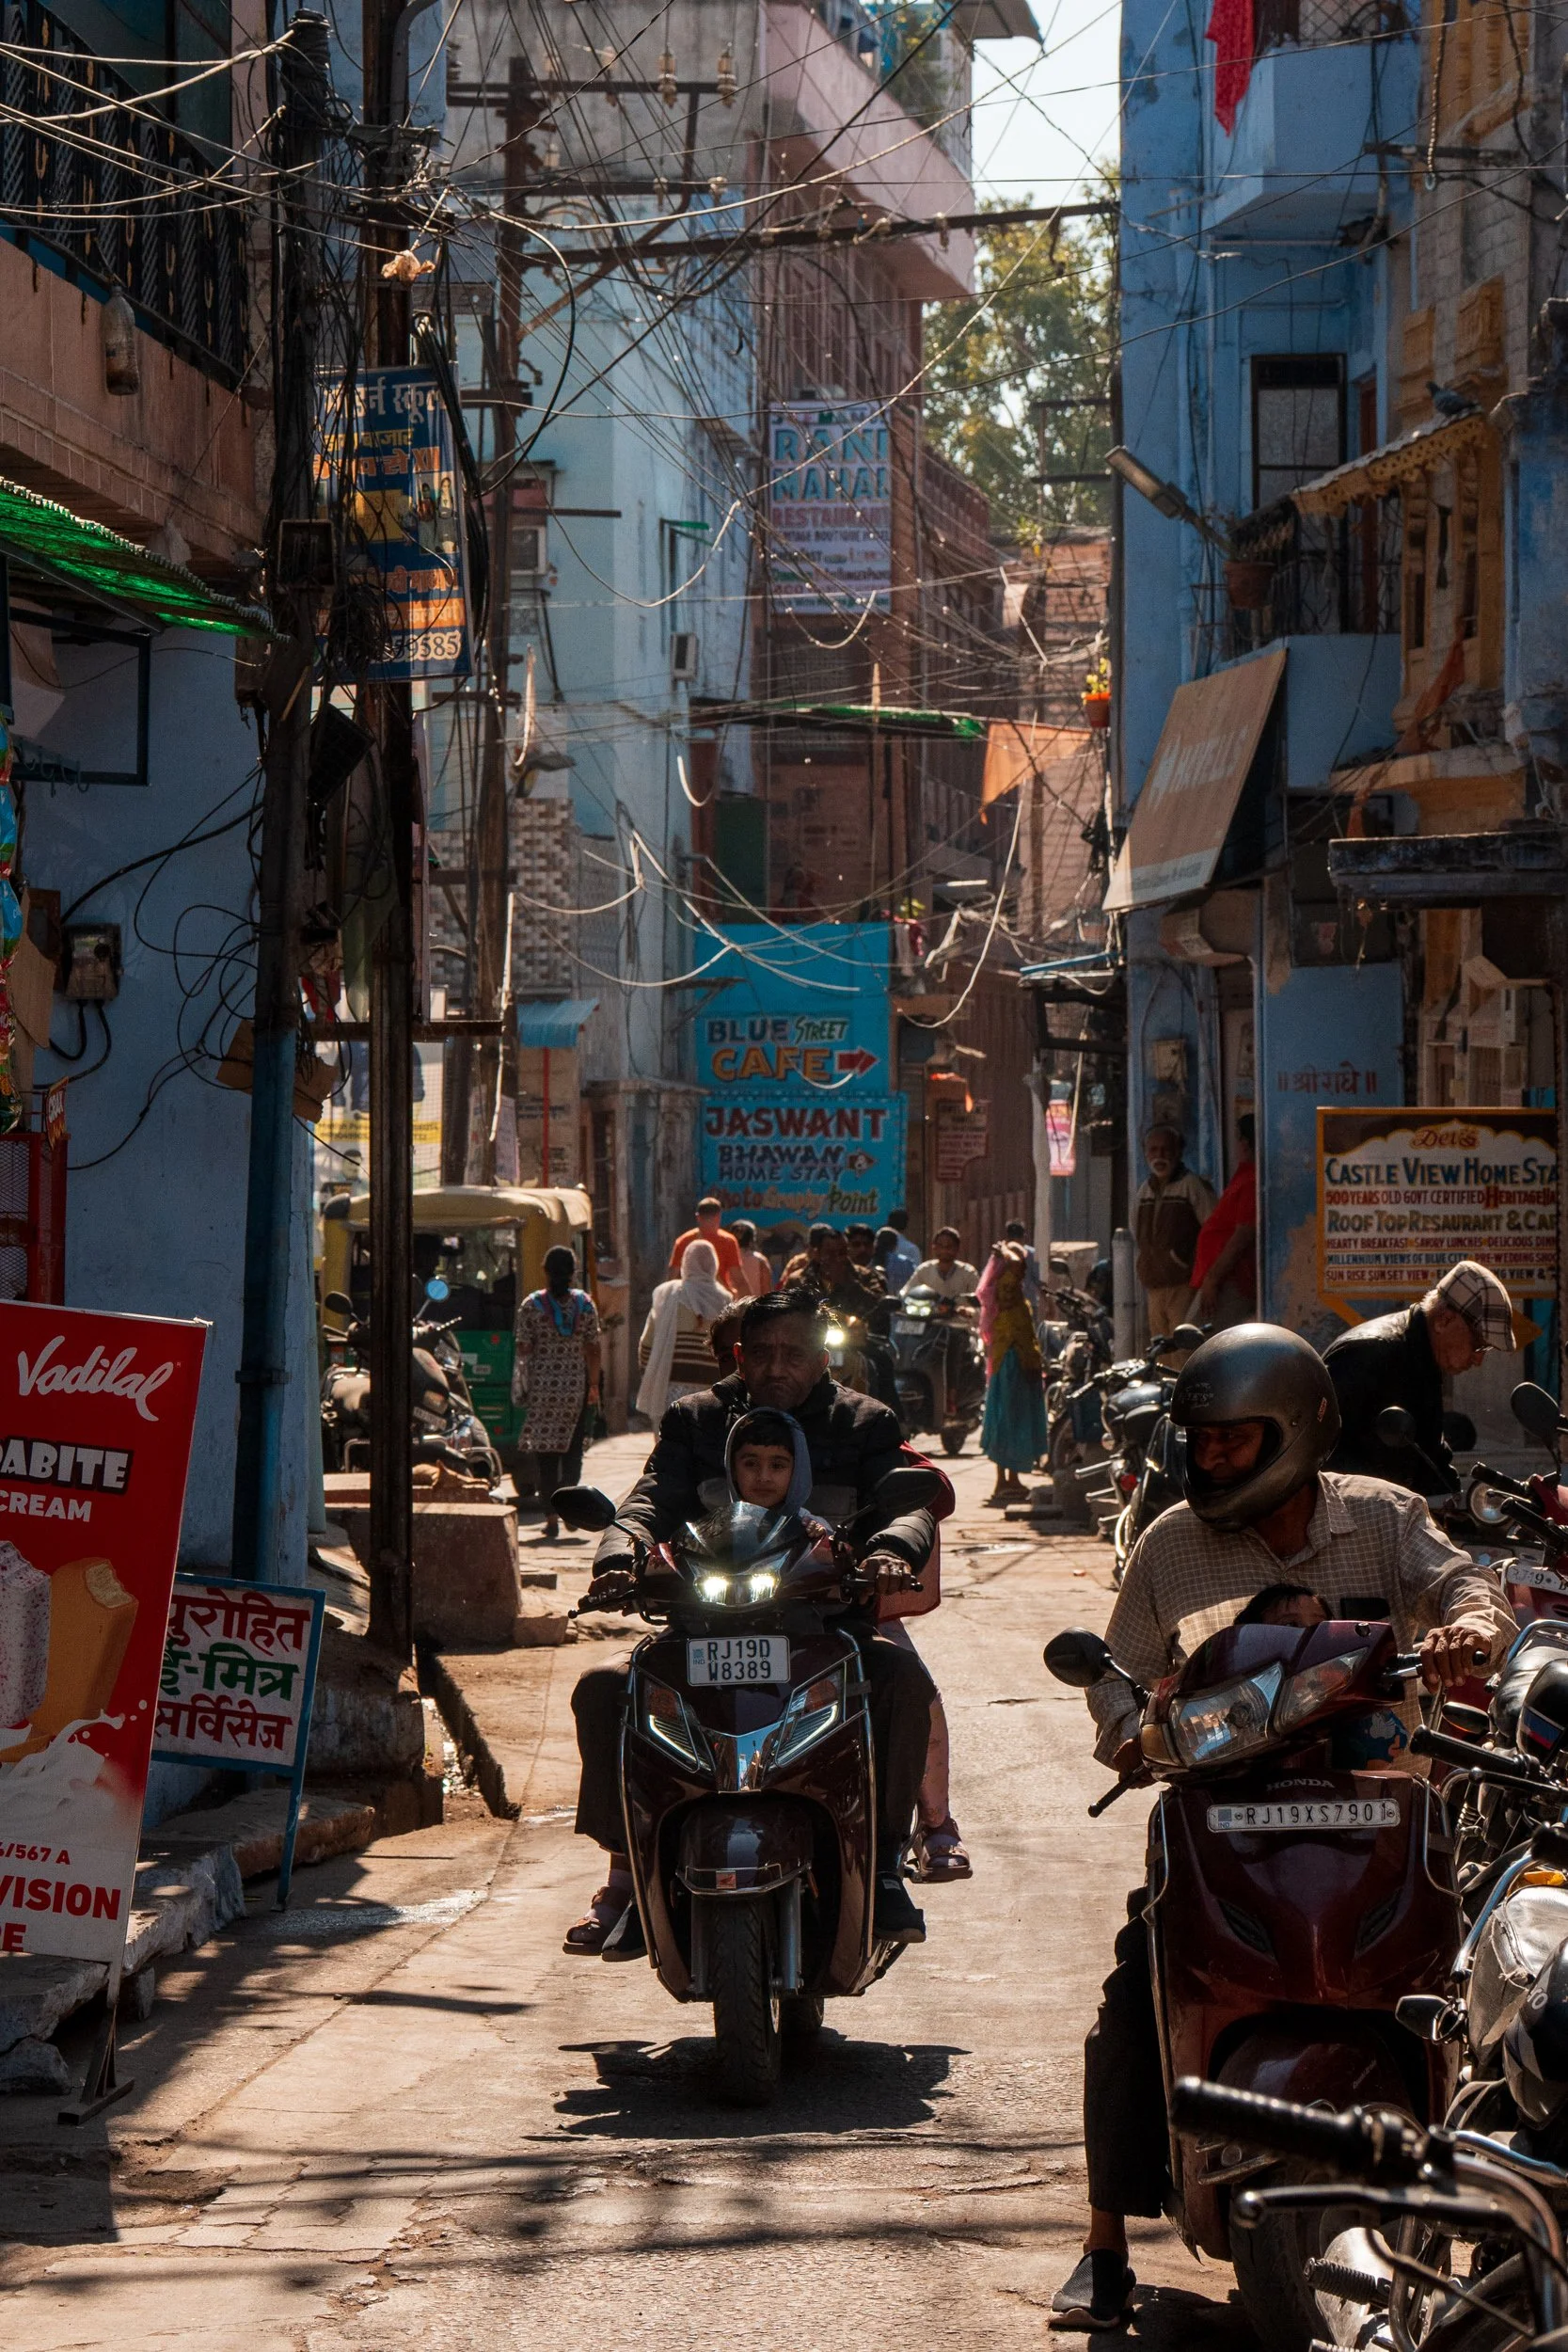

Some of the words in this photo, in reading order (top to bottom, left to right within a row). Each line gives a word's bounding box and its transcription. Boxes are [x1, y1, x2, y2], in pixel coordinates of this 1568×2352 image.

[774, 428, 889, 463] RANI
[773, 467, 890, 501] MAHAL
[707, 1018, 789, 1044] BLUE
[795, 1016, 848, 1044] STREET
[711, 1047, 833, 1082] CAFE
[705, 1107, 889, 1141] JASWANT
[718, 1144, 845, 1167] BHAWAN
[718, 1167, 781, 1183] HOME
[789, 1167, 845, 1183] STAY
[1325, 1157, 1399, 1185] CASTLE
[1402, 1157, 1461, 1185] VIEW
[1464, 1157, 1519, 1185] HOME
[1523, 1157, 1559, 1185] STA
[1325, 1190, 1349, 1205] 500
[1350, 1189, 1380, 1205] YEARS
[1381, 1189, 1402, 1205] OLD
[1431, 1189, 1484, 1205] CERTIFIED
[1327, 1210, 1374, 1232] ROOF
[1326, 1238, 1358, 1249] HEARTY
[1361, 1238, 1408, 1249] BREAKFAST
[1326, 1269, 1344, 1281] SUN
[1406, 1269, 1429, 1281] VIEW
[17, 1335, 174, 1422] Vadilal
[0, 1438, 131, 1489] ABITE
[707, 1639, 770, 1661] RJ19D
[708, 1661, 771, 1681] W8389
[1266, 1778, 1335, 1792] HONDA
[1246, 1802, 1386, 1825] RJ19XS7901
[55, 1849, 71, 1866] A
